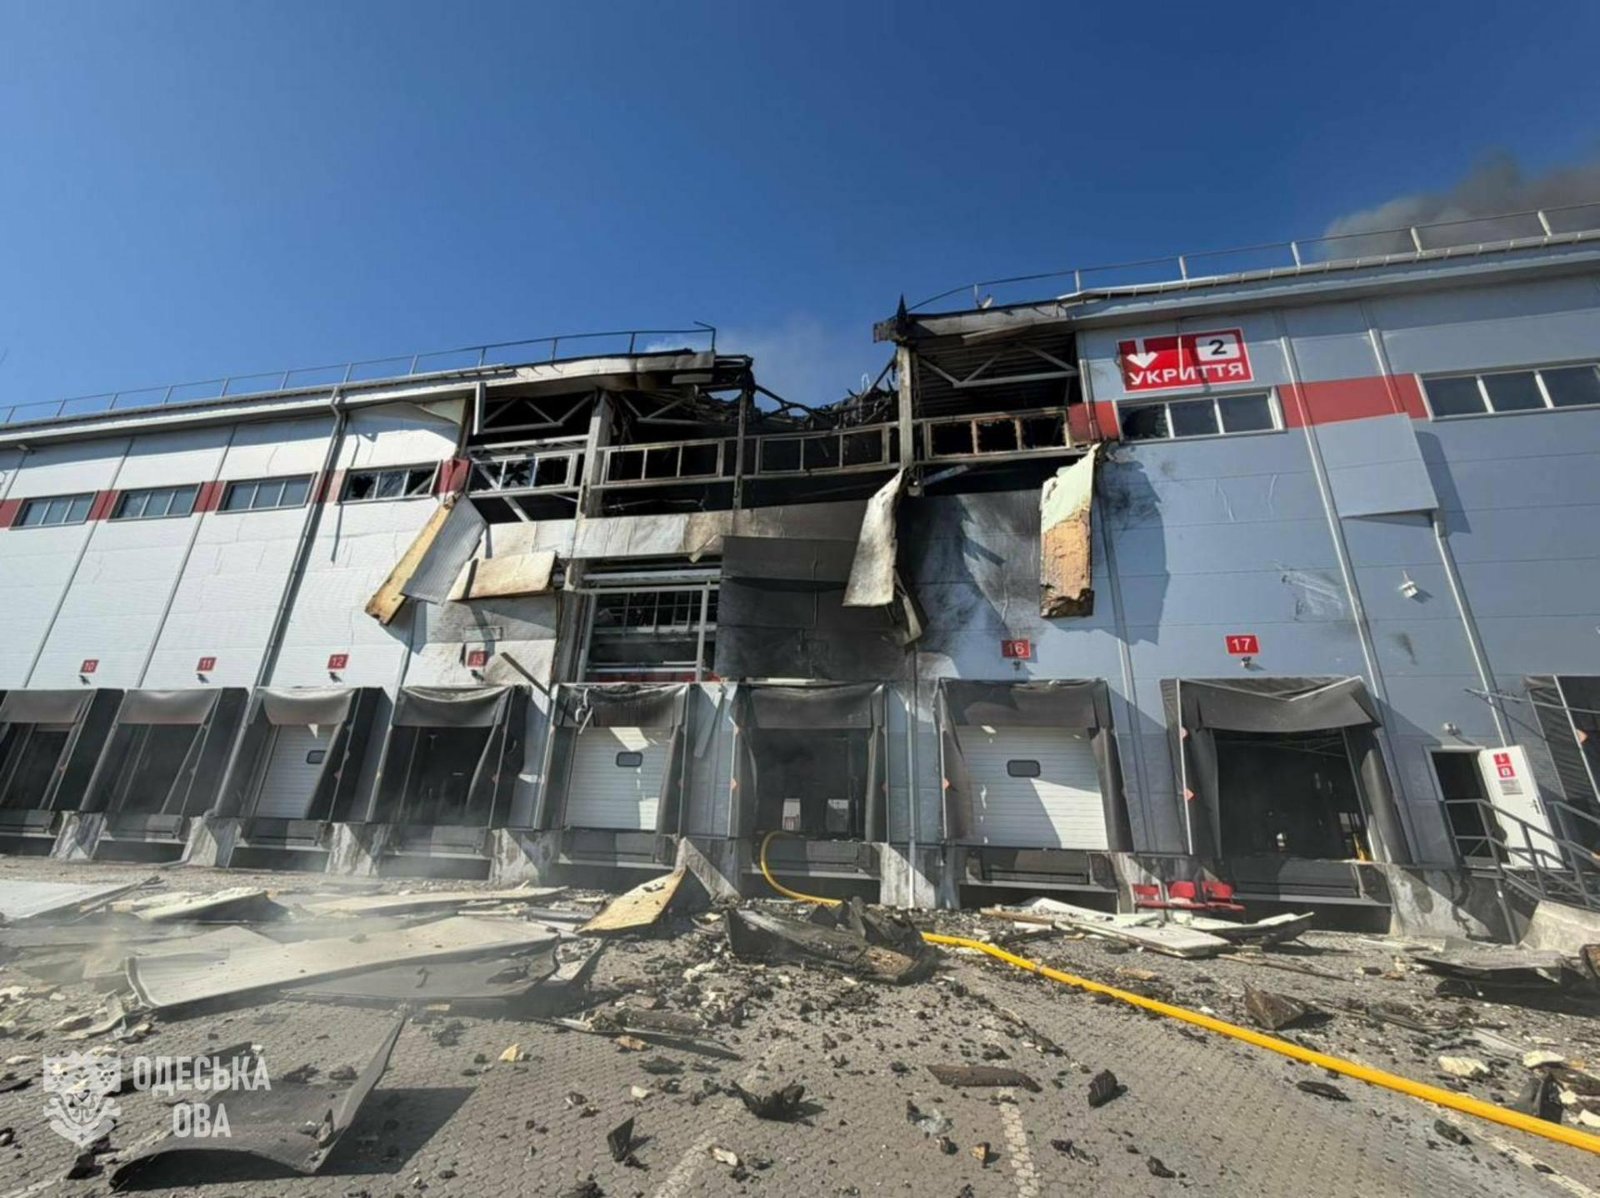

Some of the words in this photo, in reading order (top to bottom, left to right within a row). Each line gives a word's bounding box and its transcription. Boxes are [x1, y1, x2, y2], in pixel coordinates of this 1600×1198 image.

[1208, 339, 1227, 356] 2
[1128, 361, 1245, 386] УКРИТТЯ
[1008, 641, 1025, 655] 16
[1231, 638, 1251, 651] 17
[332, 656, 345, 667] 12
